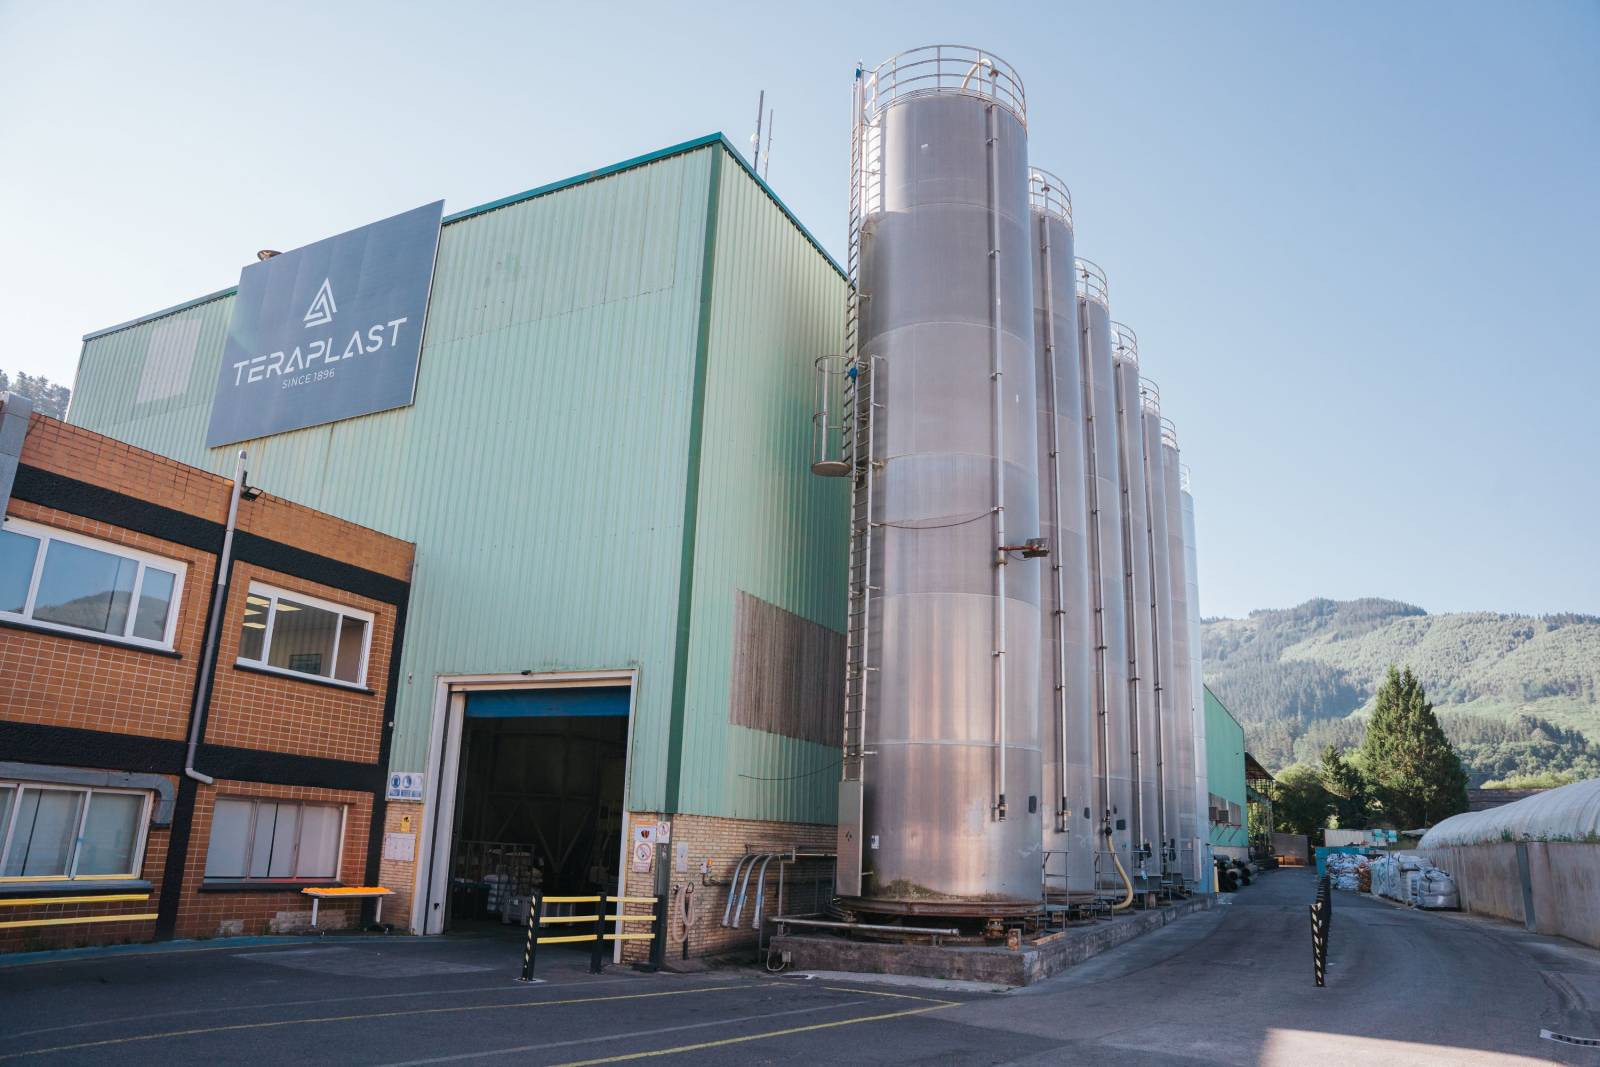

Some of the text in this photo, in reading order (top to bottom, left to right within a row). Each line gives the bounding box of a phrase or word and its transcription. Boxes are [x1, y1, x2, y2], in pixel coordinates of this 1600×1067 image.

[233, 317, 408, 386] TERAPLAST
[281, 368, 336, 389] SINCE 1896
